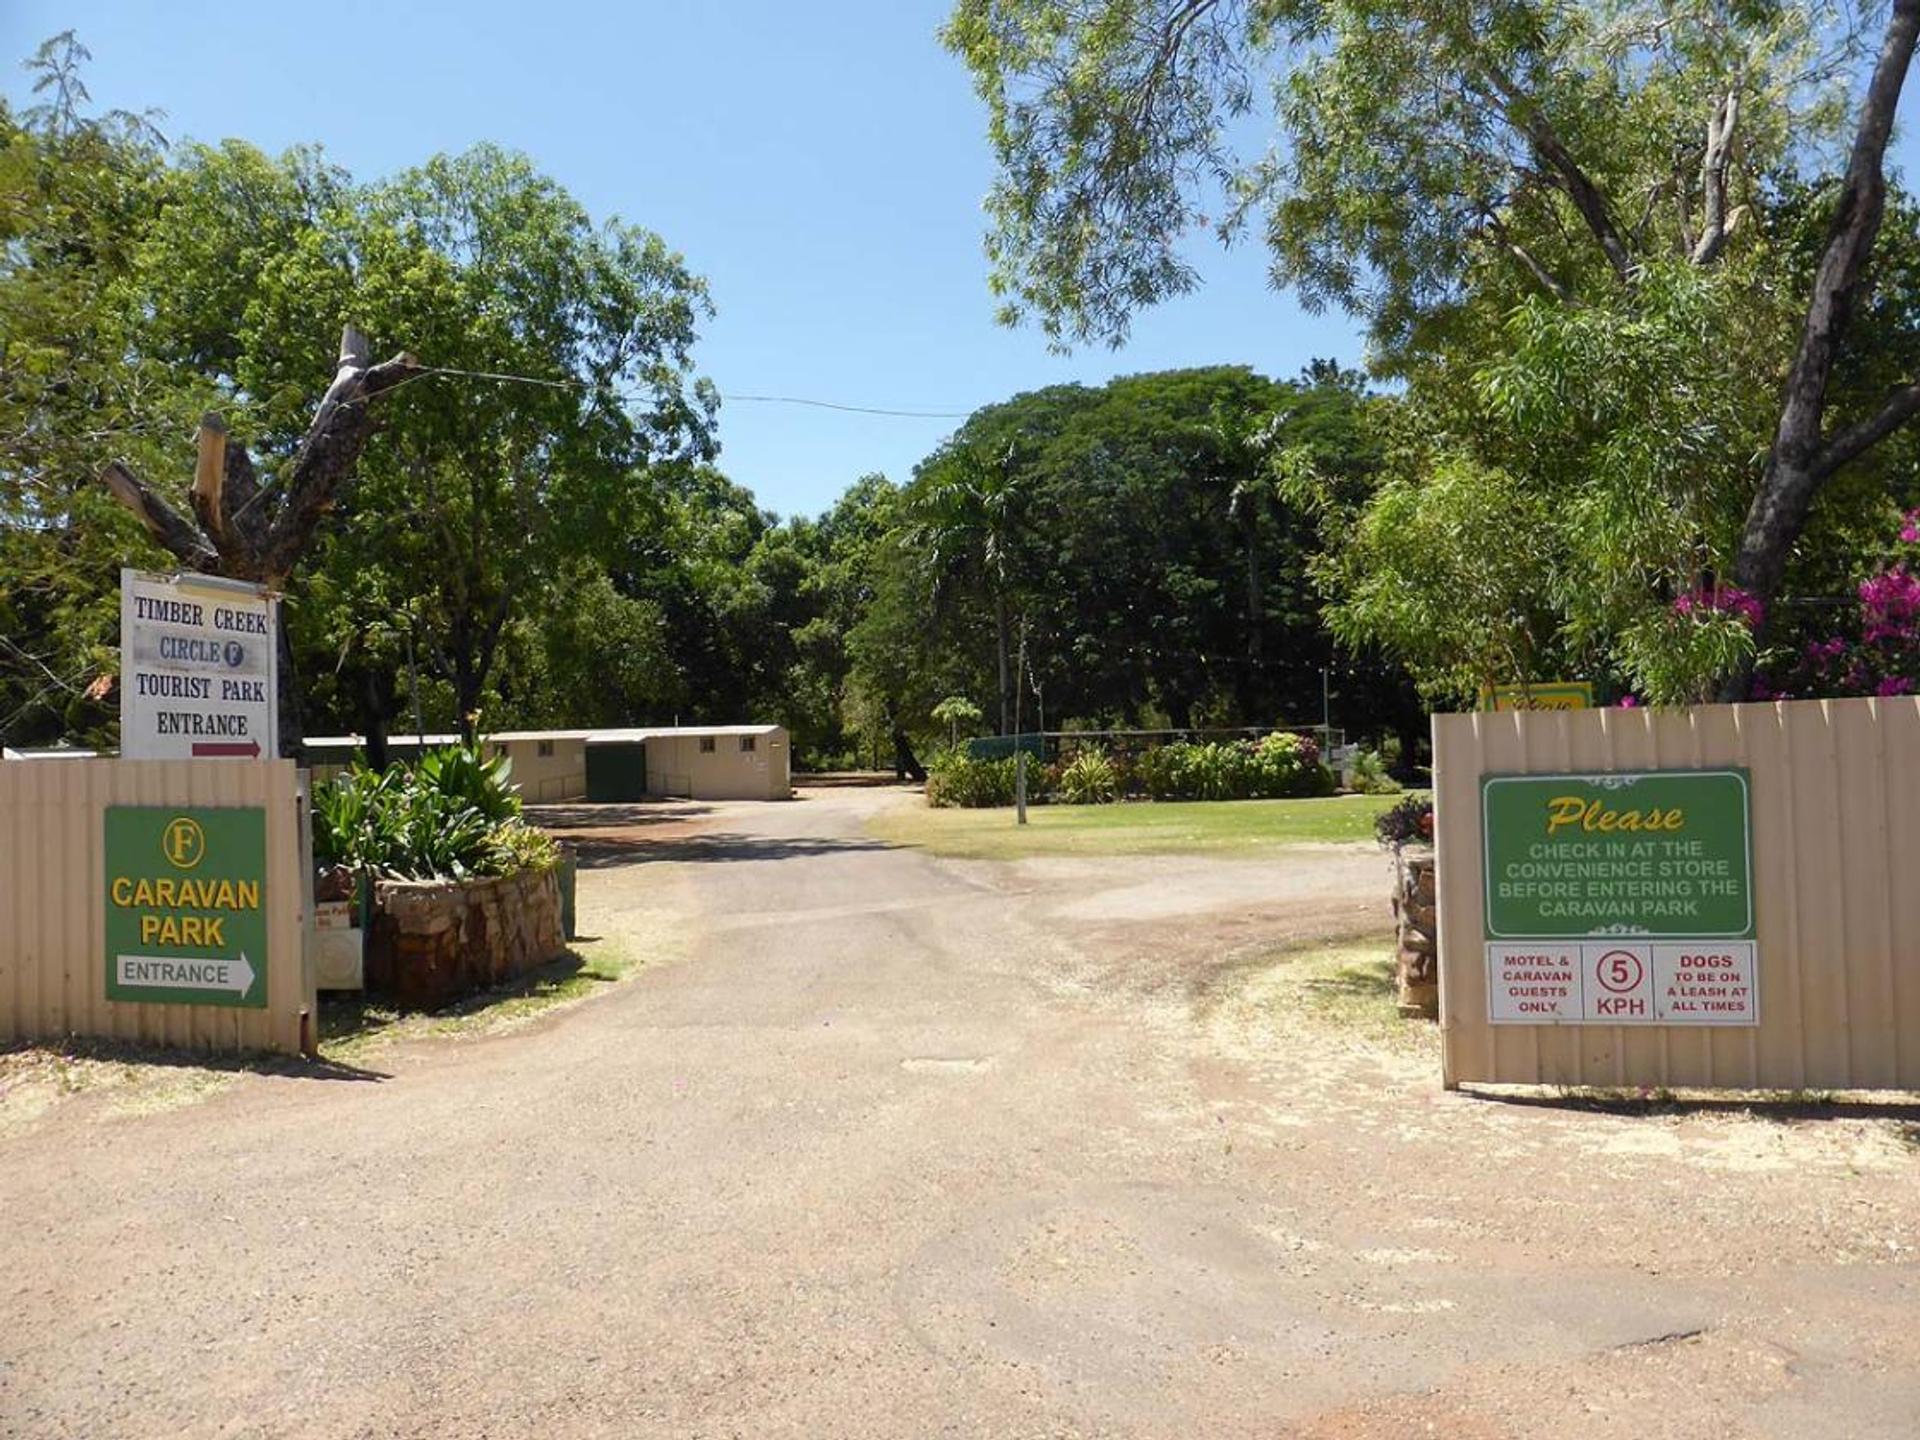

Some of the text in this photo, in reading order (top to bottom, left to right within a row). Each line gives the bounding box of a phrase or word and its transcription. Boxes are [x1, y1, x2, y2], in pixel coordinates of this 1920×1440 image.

[135, 596, 268, 635] TIMBER CREEK
[159, 636, 221, 663] CIRCLE
[136, 673, 265, 702] TOURIST PARK
[157, 711, 248, 736] ENTRANCE
[1546, 796, 1685, 835] Please
[172, 824, 196, 862] F
[1529, 840, 1703, 860] CHECK IN AT THE
[1506, 859, 1730, 879] CONVENIENCE STORE
[111, 877, 259, 910] CARAVAN
[1499, 878, 1739, 898] BEFORE ENTERING THE
[1538, 899, 1698, 917] CARAVAN PARK
[140, 915, 226, 947] PARK
[1504, 955, 1570, 967] MOTEL &
[1680, 955, 1733, 969] DOGS
[124, 961, 229, 984] ENTRANCE
[1502, 970, 1573, 982] CARAVAN
[1610, 959, 1629, 985] 5
[1675, 971, 1741, 982] TO BE ON
[1508, 986, 1568, 998] GUESTS
[1667, 986, 1748, 997] A LEASH AT
[1518, 1001, 1558, 1013] ONLY
[1596, 998, 1645, 1016] KPH
[1671, 1001, 1746, 1012] ALL TIMES
